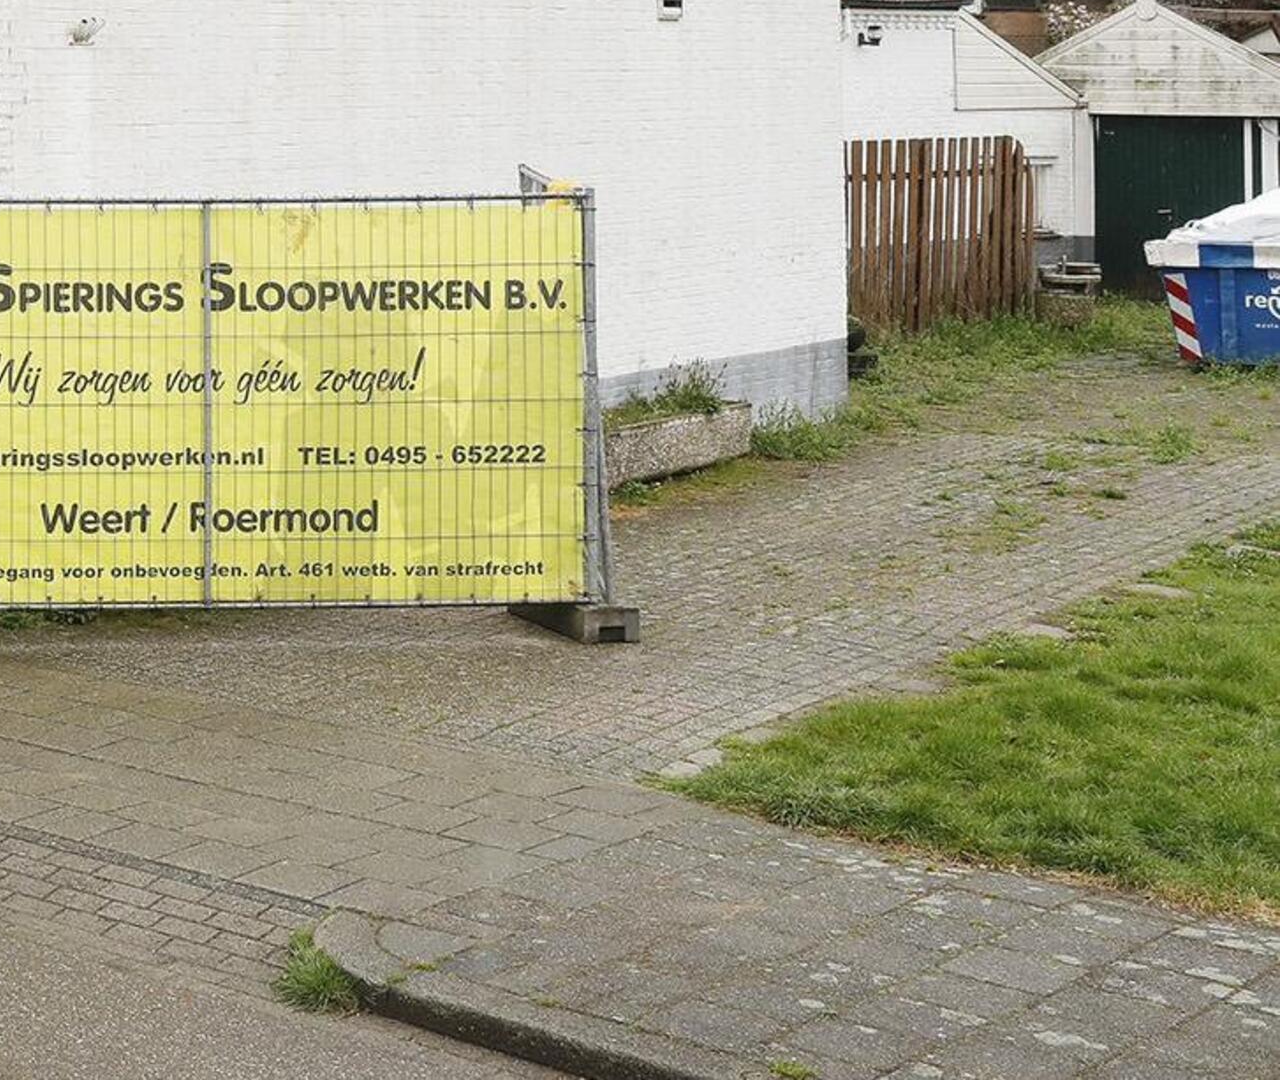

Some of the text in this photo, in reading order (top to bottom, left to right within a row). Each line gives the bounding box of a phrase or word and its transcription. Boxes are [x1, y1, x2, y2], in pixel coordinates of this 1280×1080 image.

[504, 279, 567, 310] B.V.
[57, 368, 152, 407] zorgen
[166, 368, 225, 394] voor
[233, 359, 301, 404] géén
[315, 347, 426, 404] zorgen!
[298, 447, 356, 466] TEL:
[365, 446, 427, 465] 0495
[452, 445, 546, 464] 652222
[40, 499, 379, 534] Weert / Roermond
[61, 567, 105, 579] voor
[255, 563, 292, 578] Art.
[299, 563, 334, 577] 461
[343, 562, 397, 578] wetb.
[404, 564, 439, 577] van
[446, 561, 544, 576] strafrecht
